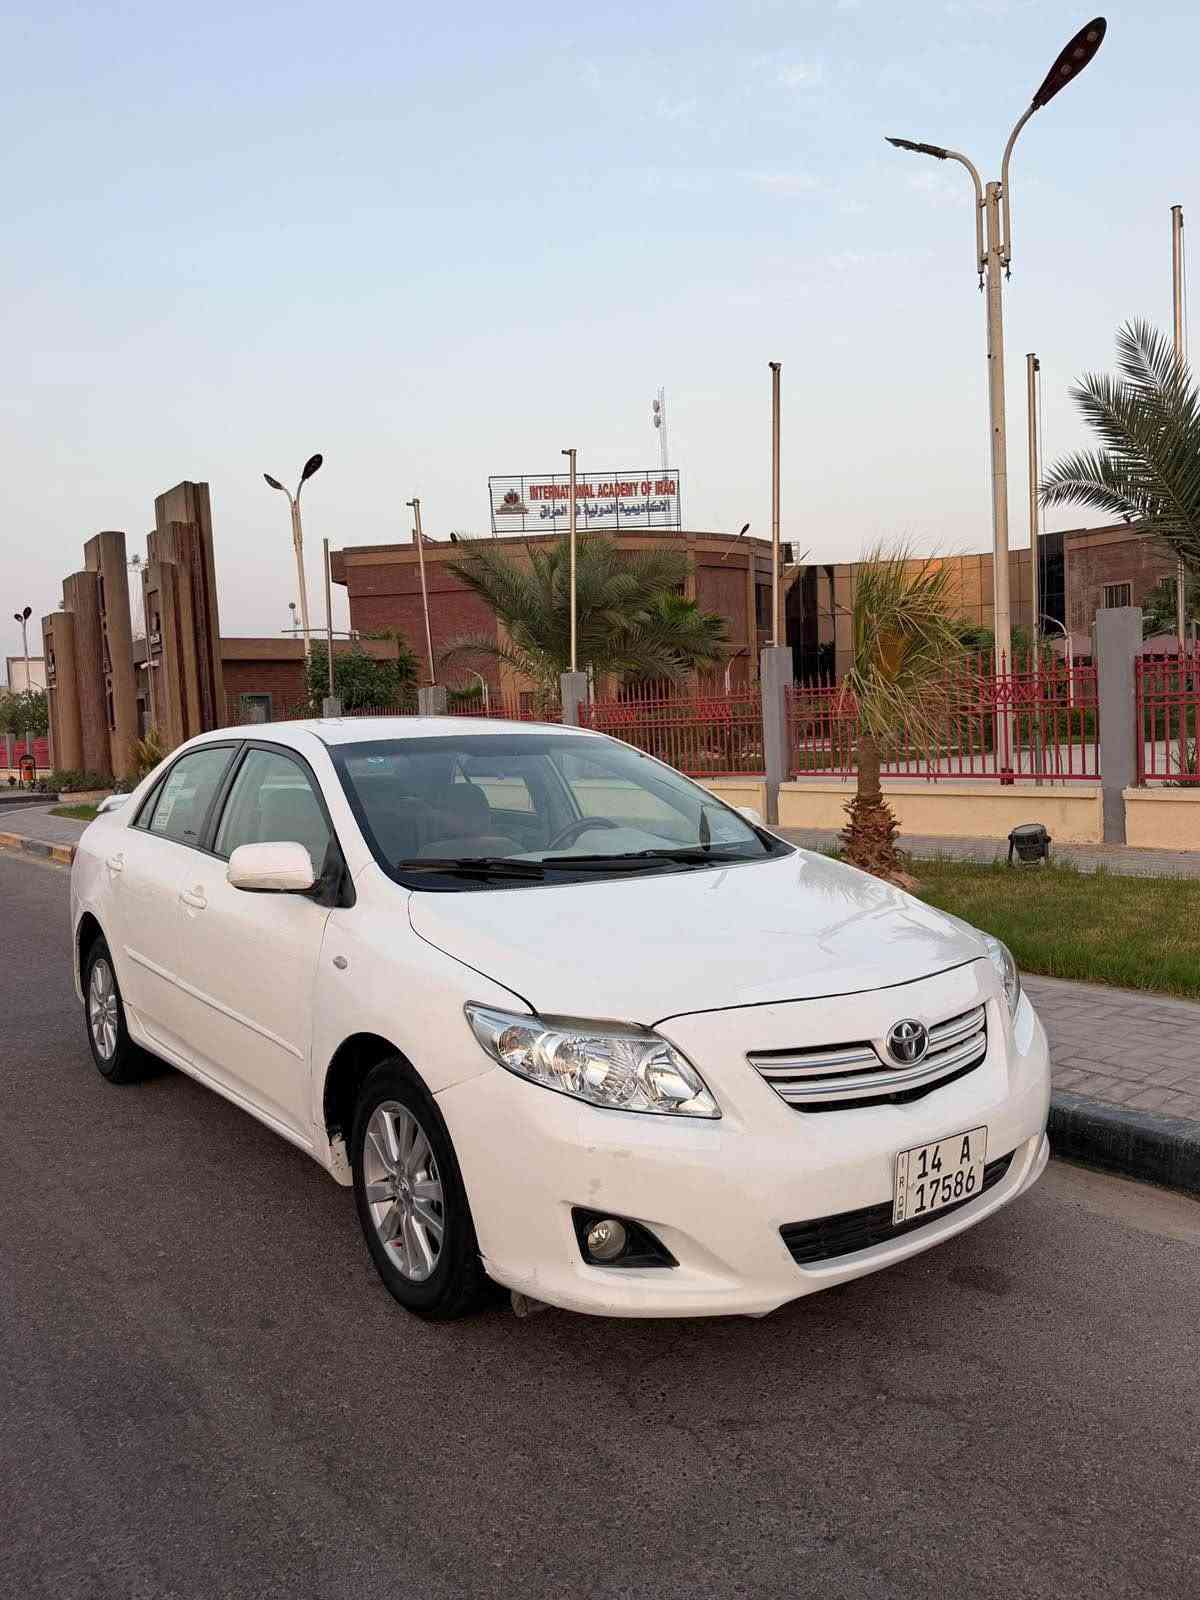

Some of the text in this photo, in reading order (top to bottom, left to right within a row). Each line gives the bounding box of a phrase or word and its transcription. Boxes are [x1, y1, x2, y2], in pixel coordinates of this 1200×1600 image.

[529, 479, 676, 500] INTERNATNAL ACADEMY OF IRAQ
[917, 1135, 971, 1179] 14 A
[914, 1166, 975, 1213] 17586
